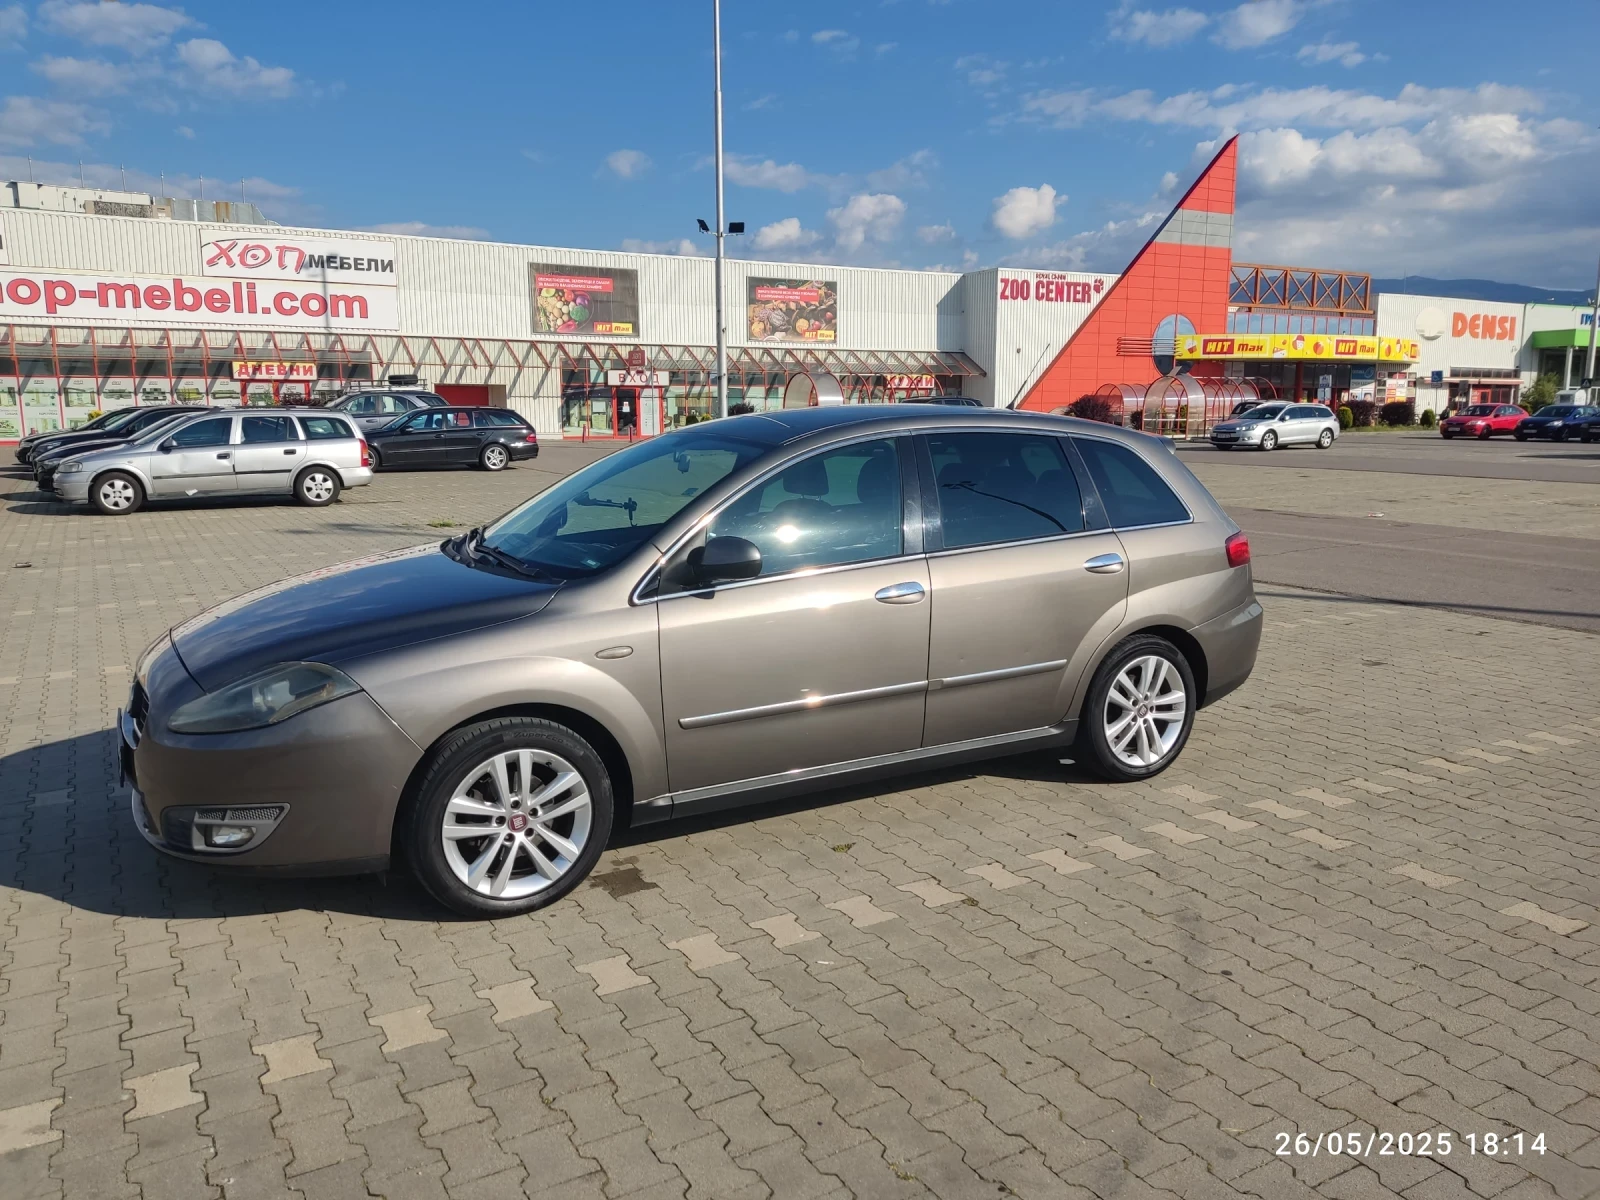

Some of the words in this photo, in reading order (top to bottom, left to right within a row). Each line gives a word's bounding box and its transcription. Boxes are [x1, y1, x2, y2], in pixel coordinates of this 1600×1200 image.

[206, 240, 307, 274] ХОП
[308, 254, 394, 273] МЕБЕЛИ
[0, 278, 369, 319] op-mebeli.com
[1000, 278, 1031, 301] ZOO
[1035, 280, 1092, 304] CENTER
[1452, 312, 1517, 341] DENSI
[1206, 341, 1231, 353] HIT
[1337, 341, 1356, 353] HIT
[238, 363, 314, 377] ДНЕВНИ
[619, 373, 660, 384] ВХОД
